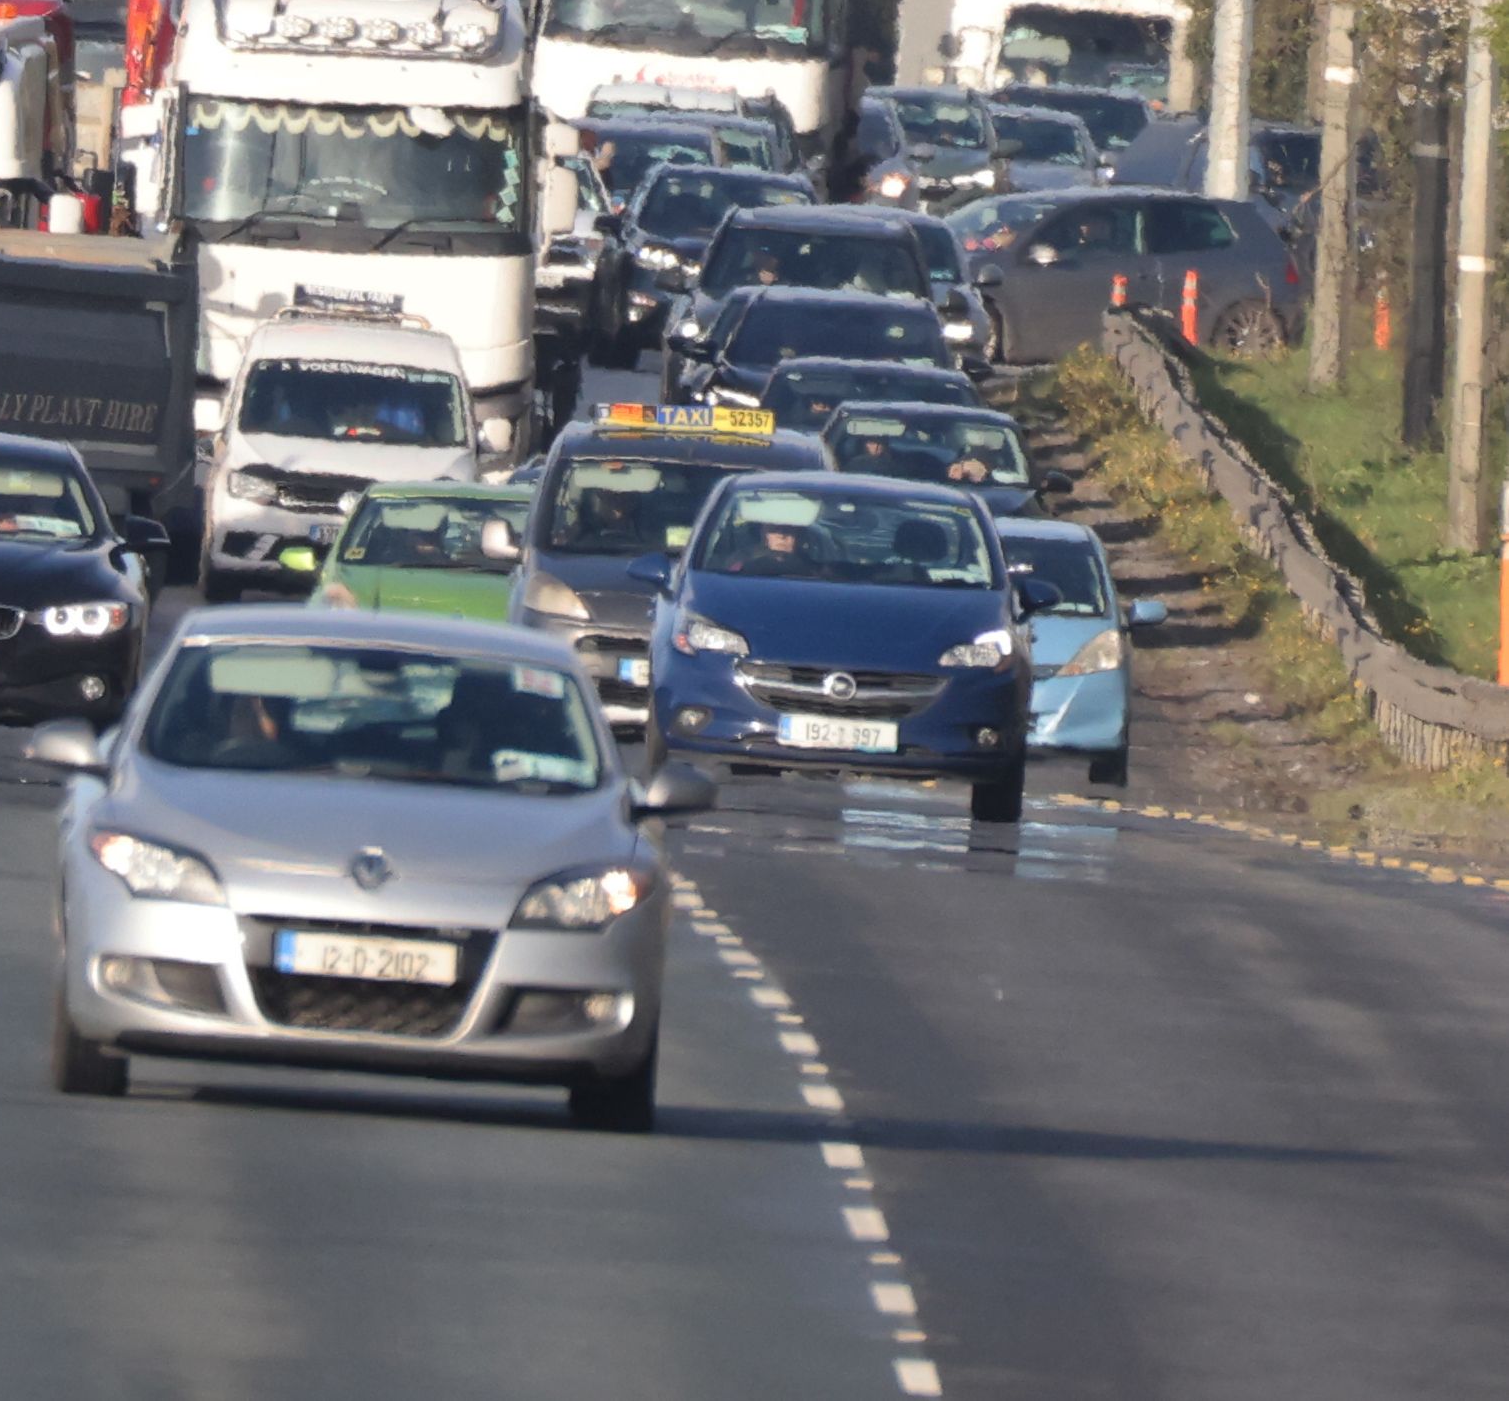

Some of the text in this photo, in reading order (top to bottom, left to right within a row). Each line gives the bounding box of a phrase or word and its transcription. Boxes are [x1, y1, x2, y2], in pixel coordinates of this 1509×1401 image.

[27, 394, 102, 427] PLANT
[101, 400, 158, 433] HIRE
[661, 406, 771, 430] TAXI 52357
[323, 945, 430, 983] 12-D-2102
